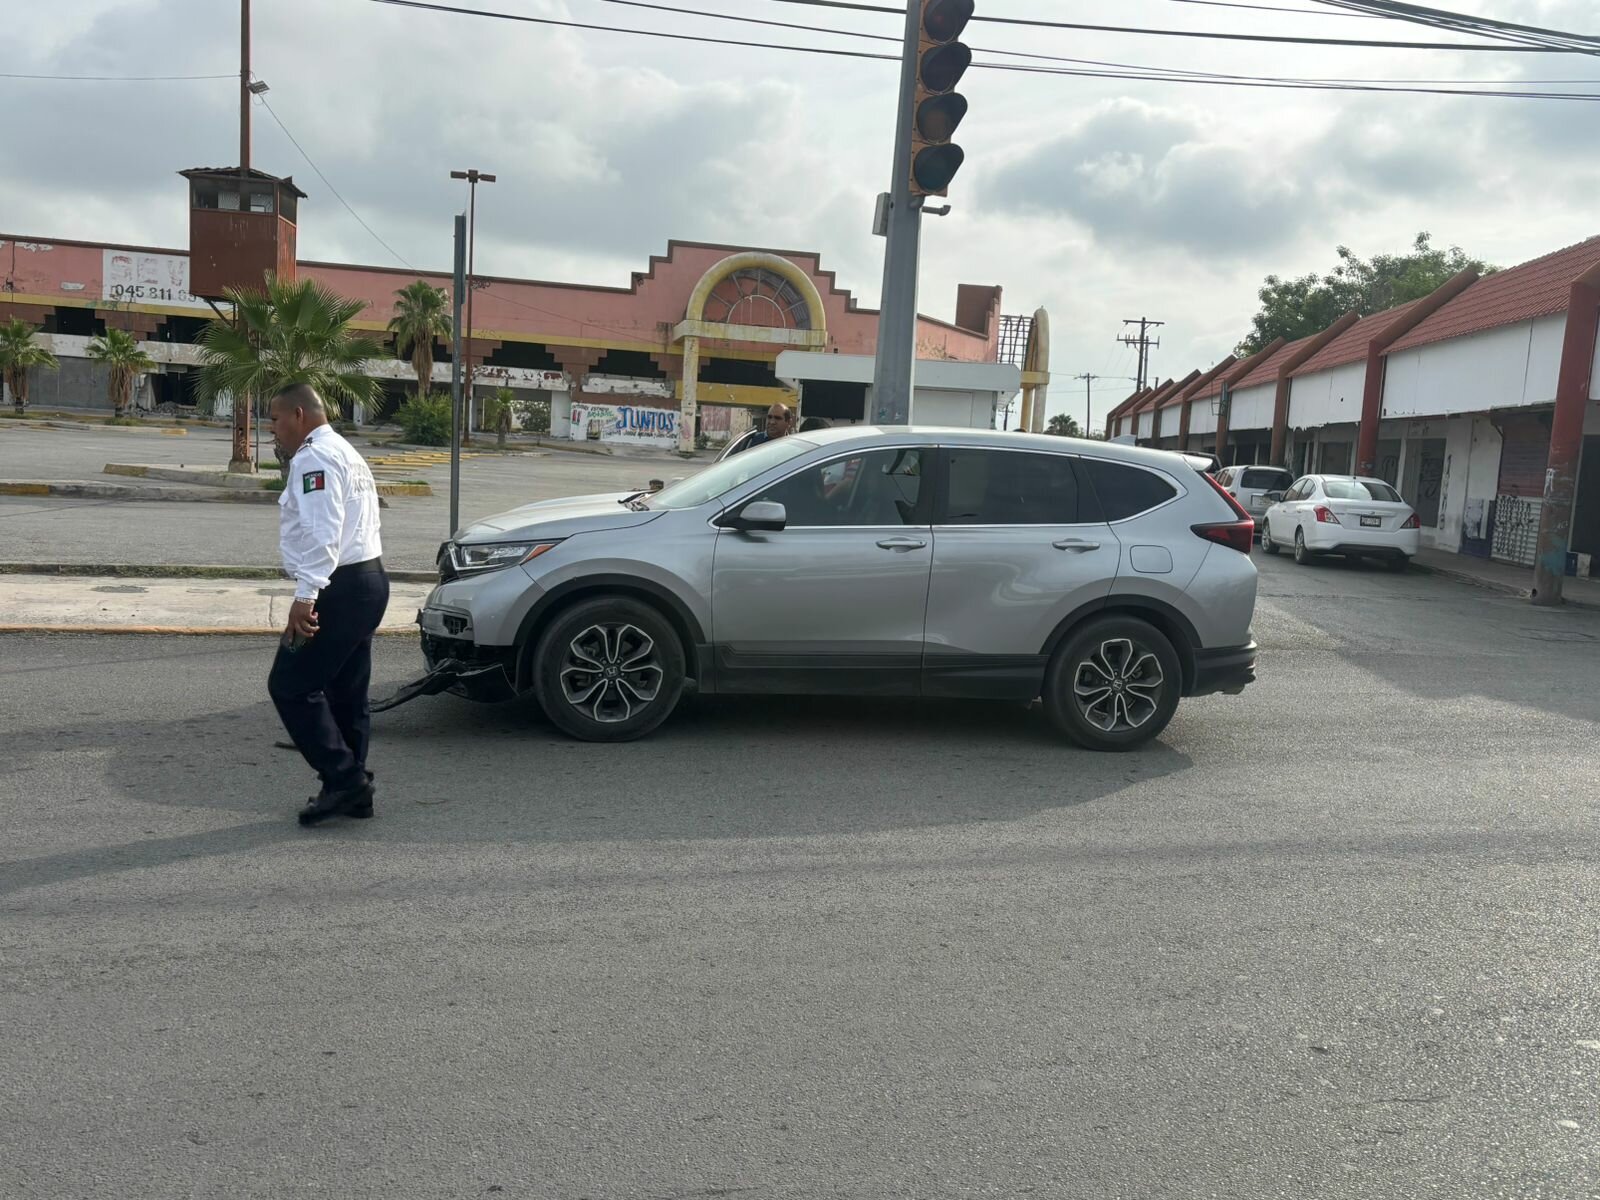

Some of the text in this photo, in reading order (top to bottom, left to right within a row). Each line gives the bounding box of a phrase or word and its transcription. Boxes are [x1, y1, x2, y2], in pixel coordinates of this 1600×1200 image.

[115, 284, 145, 298] 045
[149, 287, 171, 300] 811
[616, 406, 674, 433] JUNTOS
